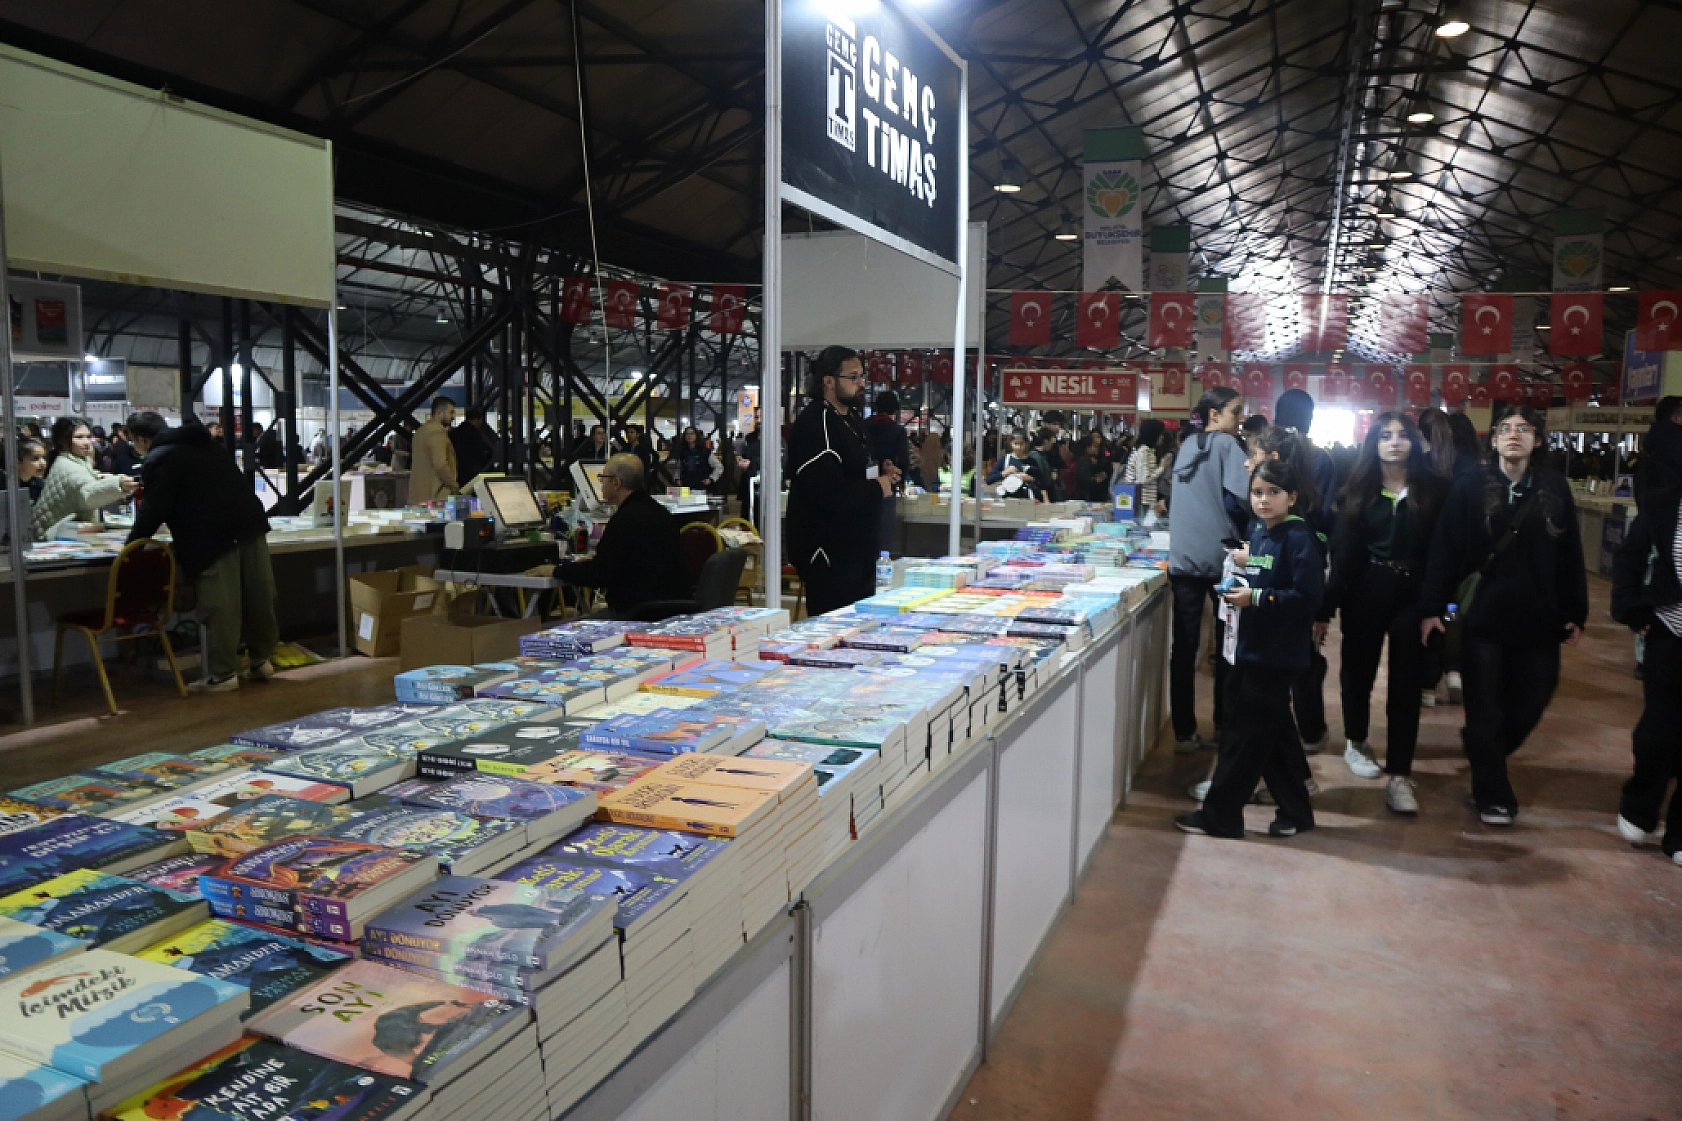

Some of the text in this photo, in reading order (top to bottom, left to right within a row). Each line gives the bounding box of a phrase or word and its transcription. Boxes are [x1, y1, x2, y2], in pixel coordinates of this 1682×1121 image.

[862, 35, 936, 145] GENÇ
[862, 107, 937, 208] TİMAŞ
[414, 891, 458, 912] AYI
[300, 981, 364, 1016] SON
[330, 990, 387, 1024] AYI
